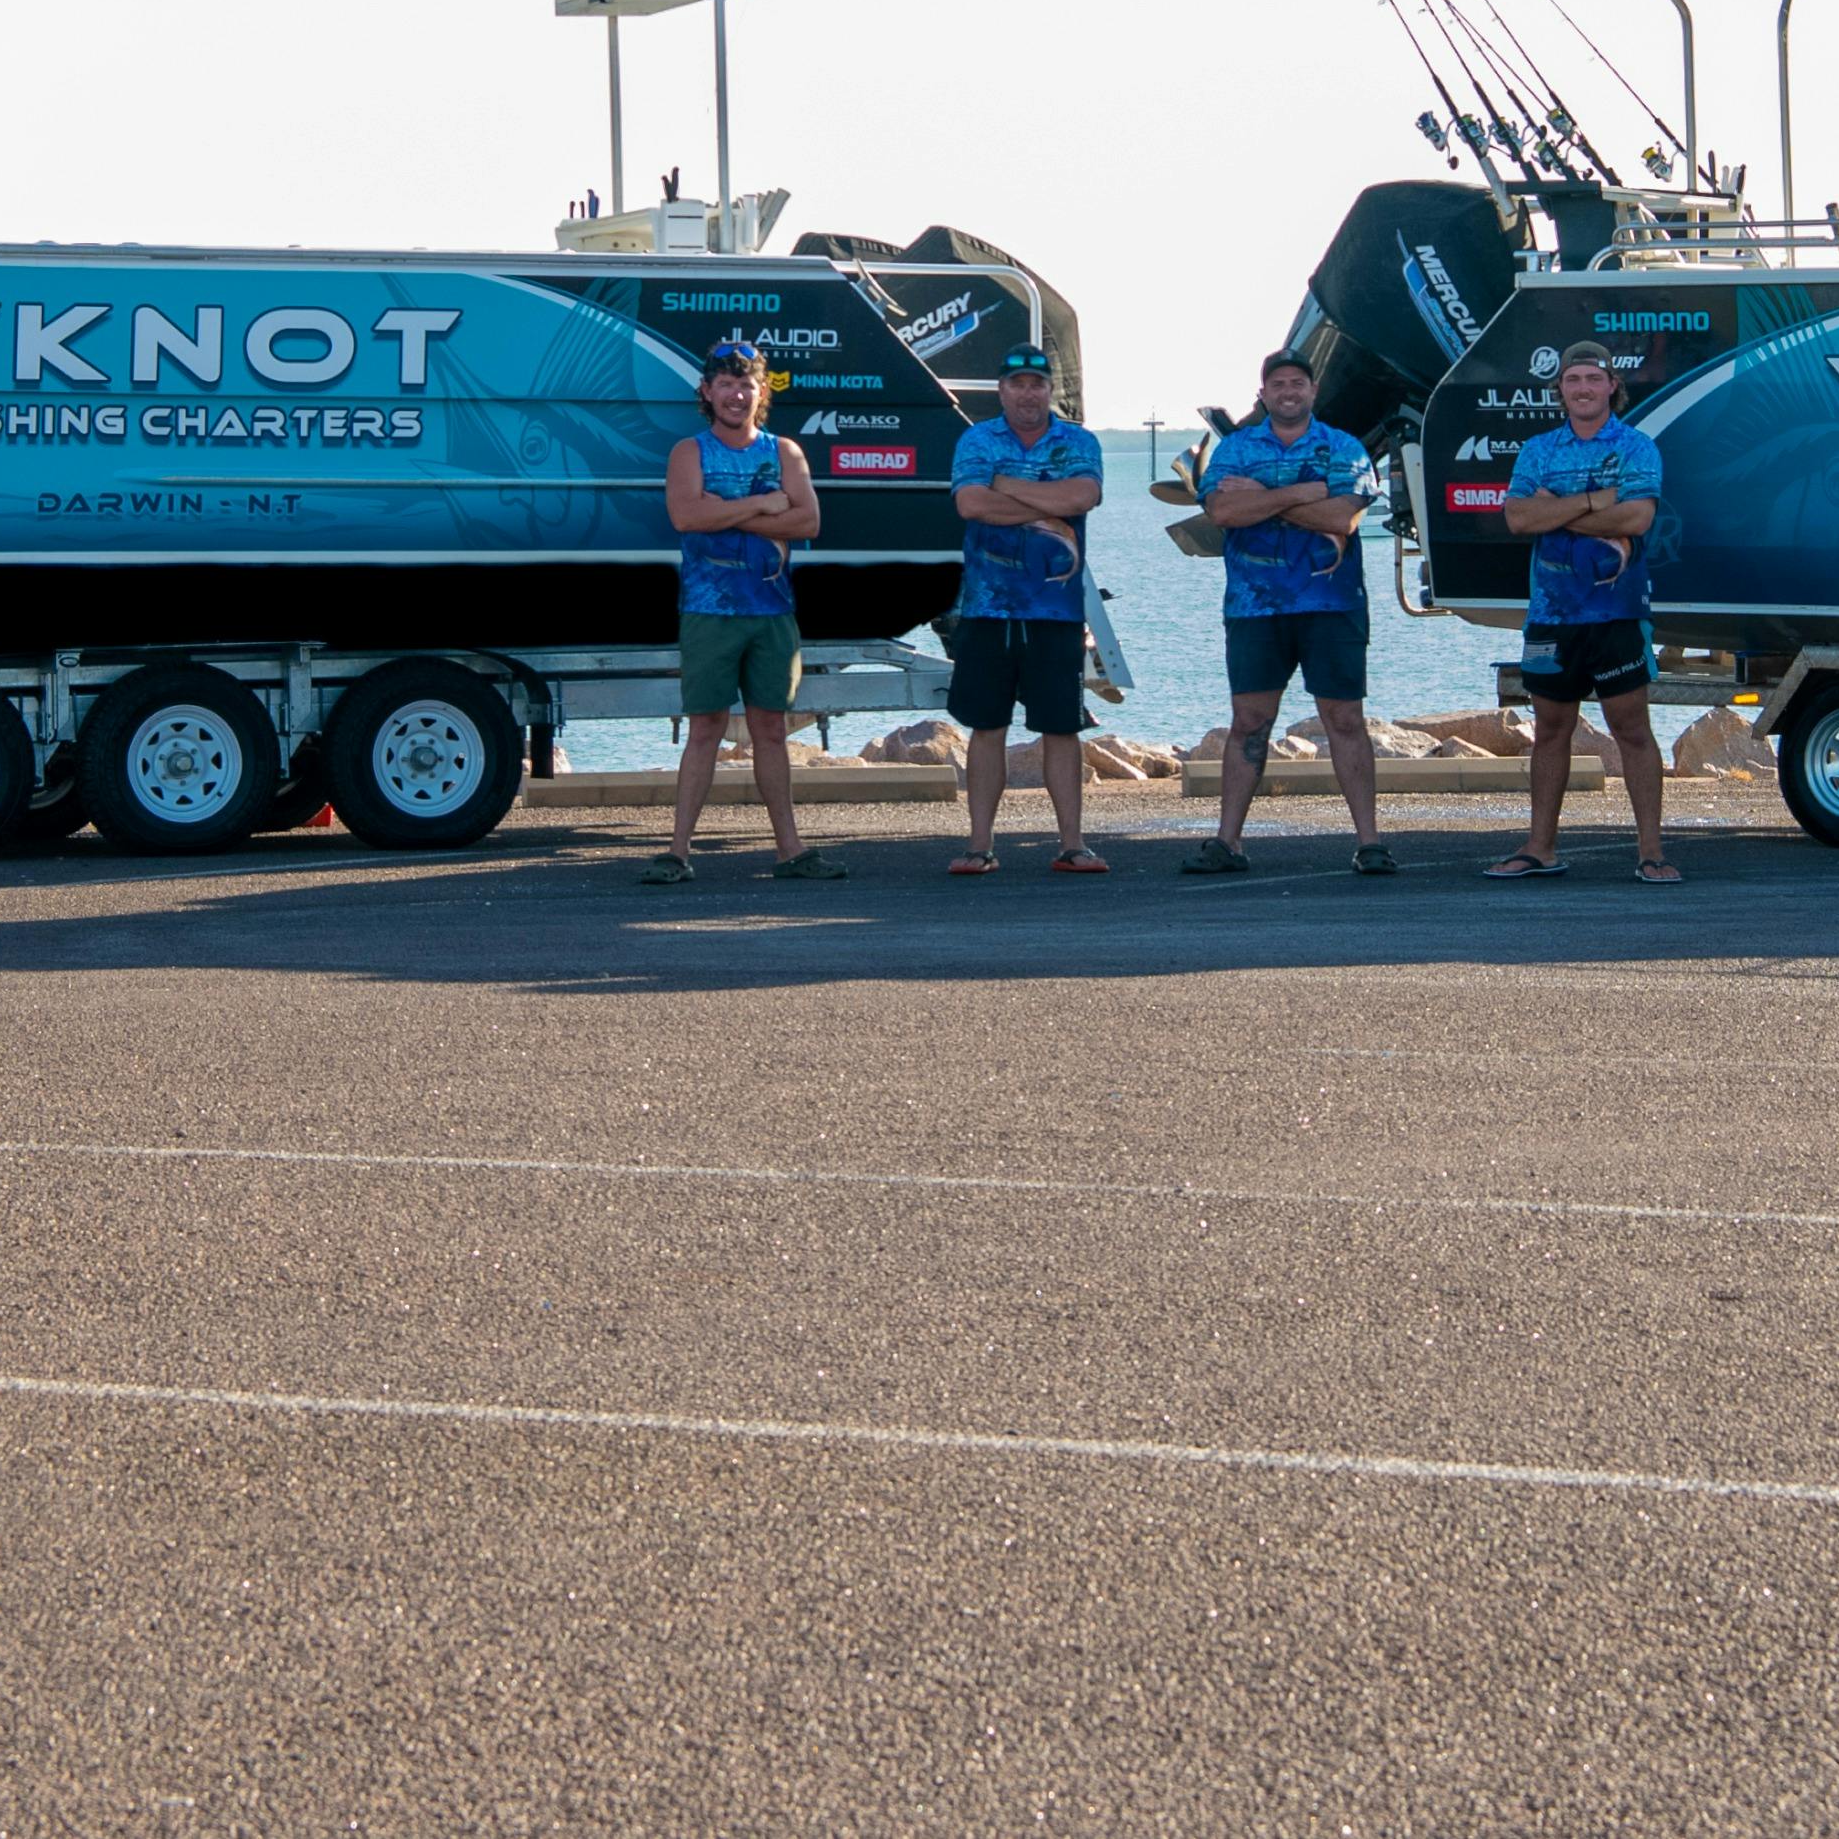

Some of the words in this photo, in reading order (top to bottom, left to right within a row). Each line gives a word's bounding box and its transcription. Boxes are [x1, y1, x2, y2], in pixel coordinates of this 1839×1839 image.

[662, 292, 781, 313] SHIMANO
[1414, 244, 1483, 343] MERCU
[896, 291, 972, 344] RCURY
[1594, 311, 1710, 332] SHIMANO
[755, 328, 839, 348] AUDIO
[763, 350, 811, 359] ARINE
[792, 374, 837, 389] MINN
[839, 375, 884, 389] KOTA
[1478, 389, 1507, 407] JL
[1510, 389, 1561, 407] AUD
[141, 407, 422, 439] CHARTERS
[837, 415, 900, 425] MAKO
[1490, 440, 1526, 449] MA
[838, 452, 908, 469] SIMRAD
[36, 492, 203, 514] DARWIN
[1453, 489, 1507, 506] SIMRA
